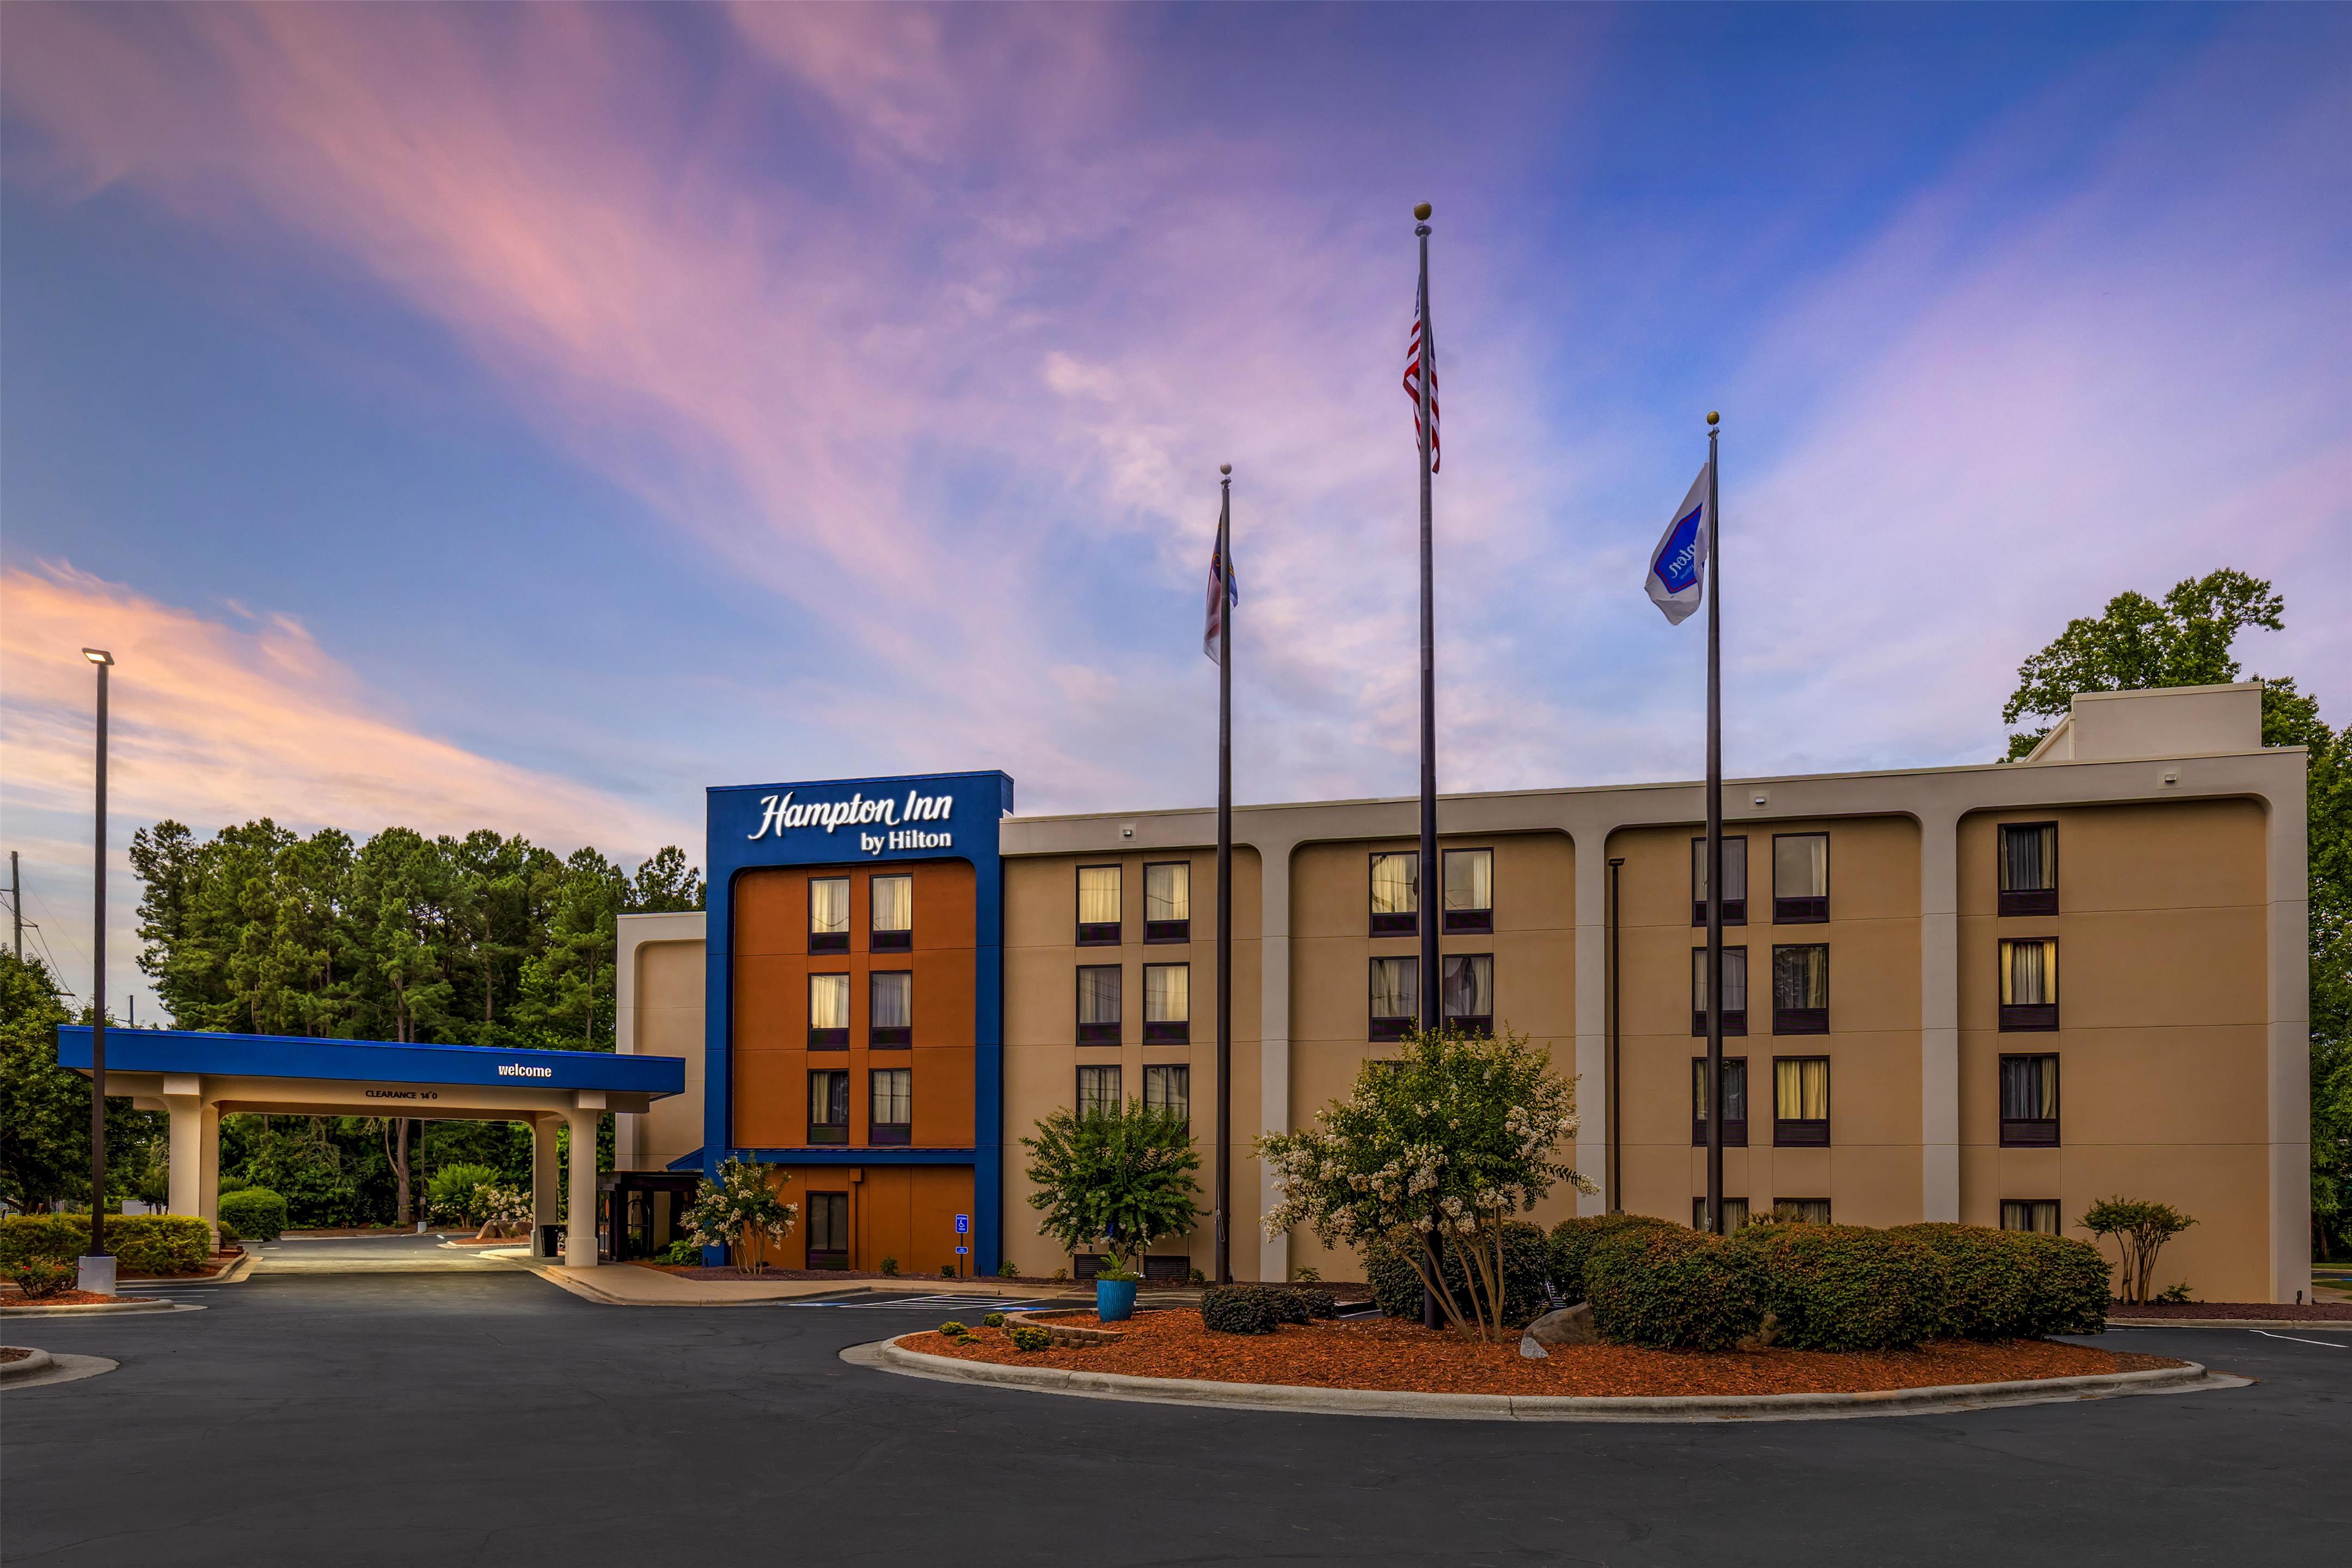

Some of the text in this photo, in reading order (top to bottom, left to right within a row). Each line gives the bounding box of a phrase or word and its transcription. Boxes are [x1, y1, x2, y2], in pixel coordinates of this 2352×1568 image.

[748, 790, 952, 840] Hampton Inn
[861, 830, 952, 855] by Hilton
[498, 1063, 552, 1077] welcome
[365, 1090, 416, 1099] CLEARANCE
